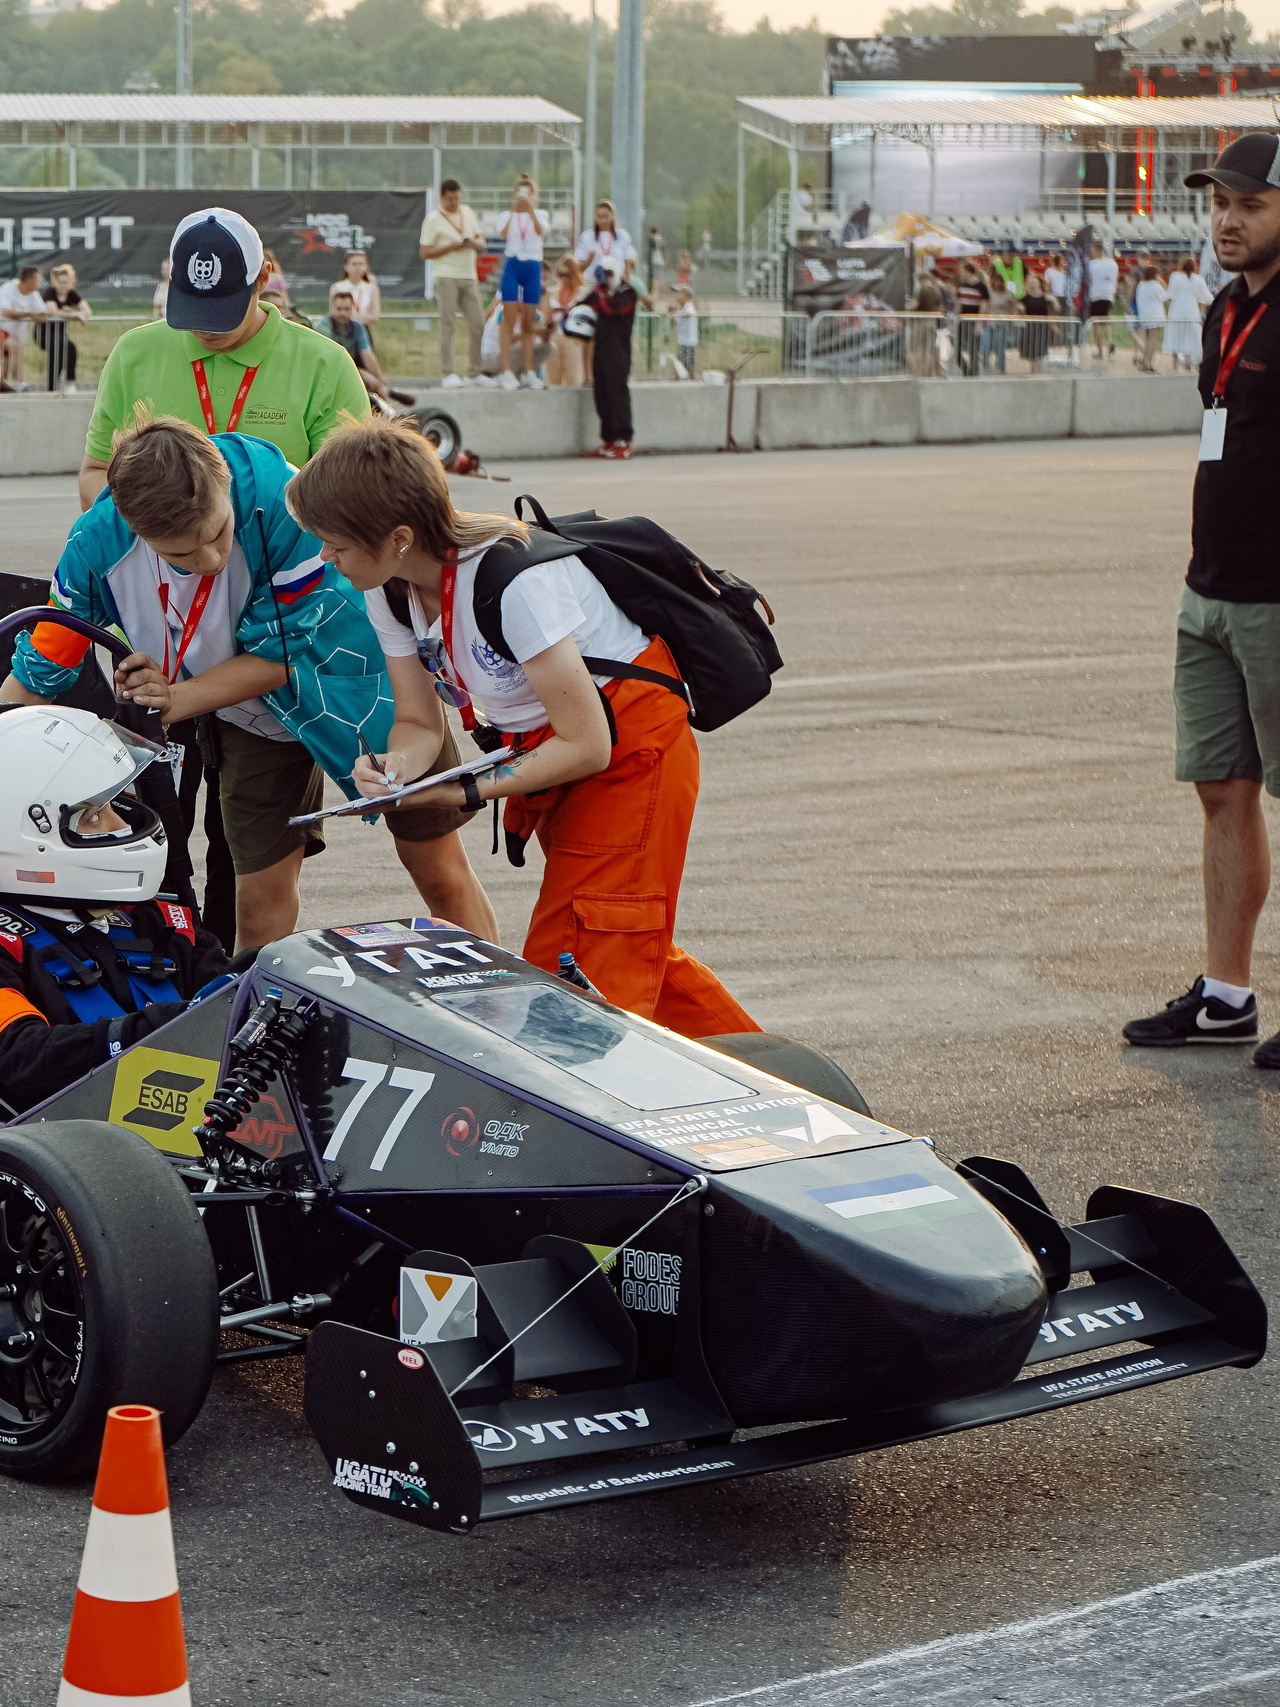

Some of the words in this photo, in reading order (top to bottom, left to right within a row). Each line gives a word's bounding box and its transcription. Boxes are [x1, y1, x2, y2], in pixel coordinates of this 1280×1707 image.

[306, 940, 526, 987] УГАТ
[137, 1085, 189, 1115] ESAB
[322, 1057, 436, 1172] 77
[618, 1118, 661, 1132] UFA
[660, 1109, 723, 1125] STATE
[724, 1095, 813, 1117] AVIATION
[483, 1119, 530, 1142] ОДК
[632, 1118, 745, 1140] TECHNICAL
[649, 1125, 766, 1148] UNIVERSITY
[479, 1141, 520, 1158] УМПО
[622, 1247, 682, 1285] FODES
[1038, 1301, 1145, 1343] УГАТУ
[401, 1355, 419, 1366] HEL
[1040, 1381, 1070, 1393] UFA
[1069, 1372, 1106, 1387] STATE
[1105, 1358, 1165, 1381] AVIATION
[1051, 1380, 1119, 1400] TECHNICAL
[1119, 1362, 1189, 1384] UNIVERSITY
[515, 1407, 650, 1444] УГАТУ
[332, 1475, 366, 1494] RACING
[366, 1482, 391, 1499] TEAM
[506, 1484, 589, 1504] Republic
[588, 1480, 611, 1491] of
[607, 1459, 736, 1488] Bashkortostan
